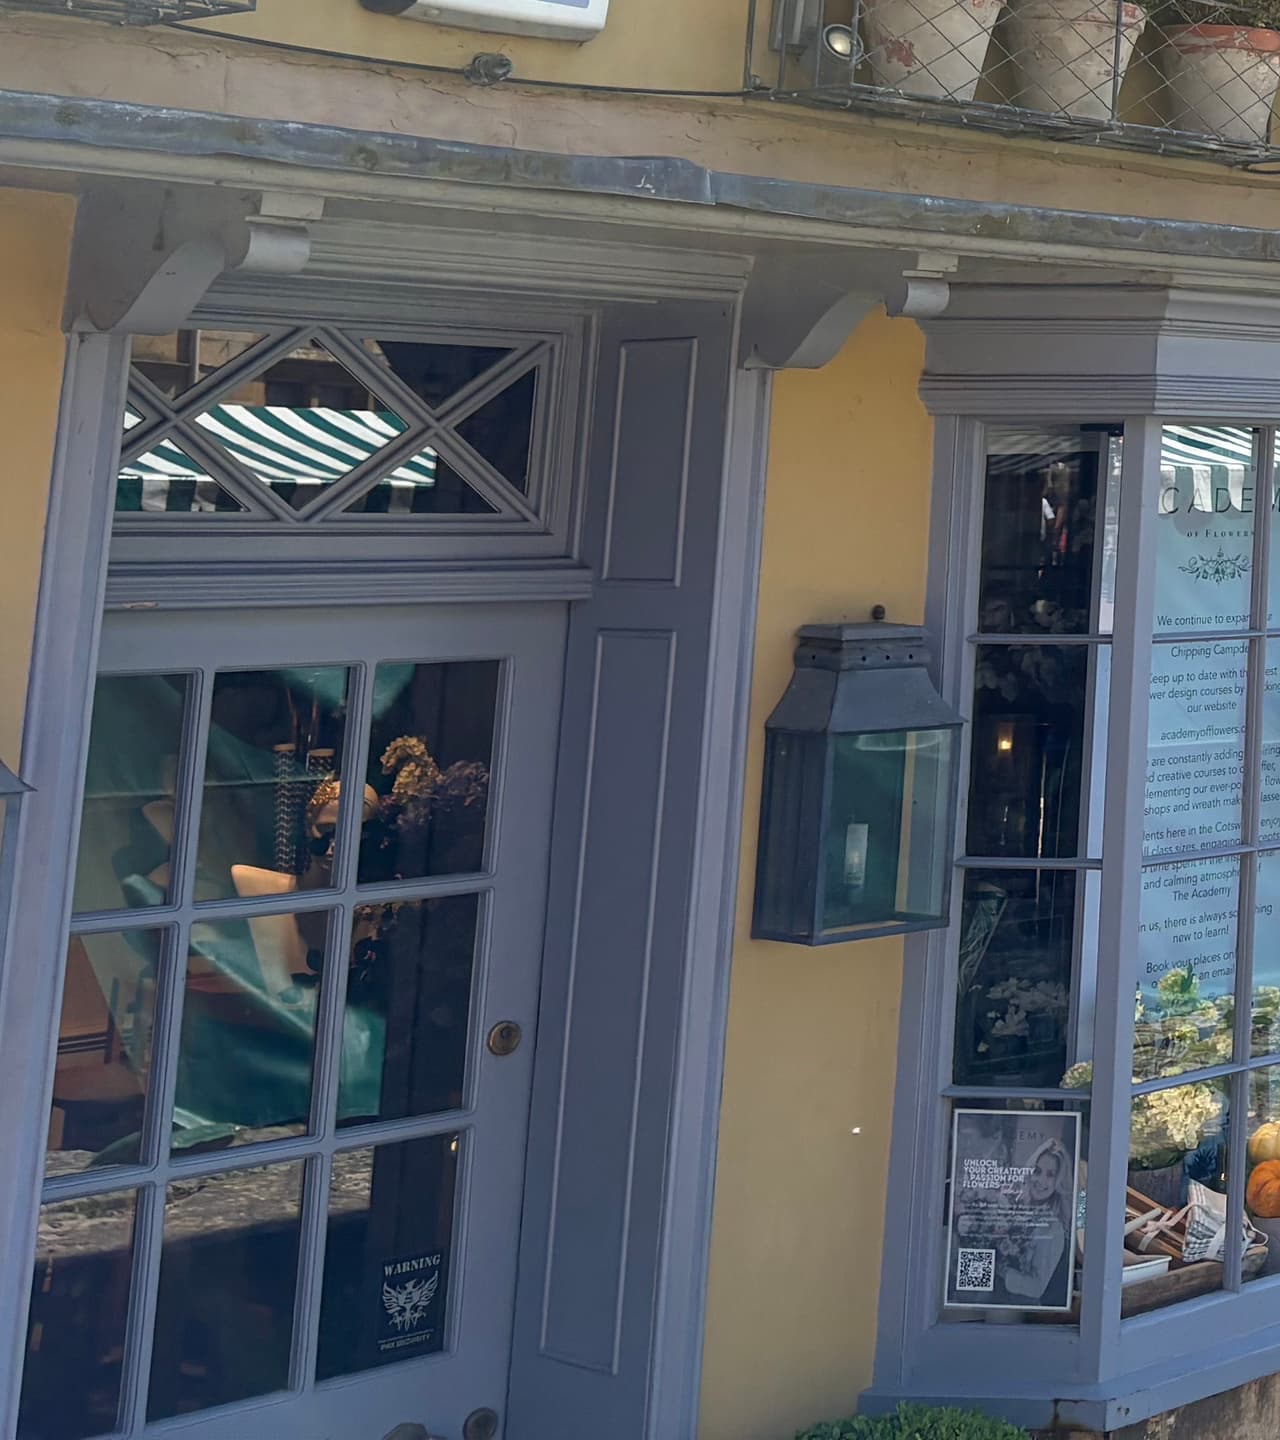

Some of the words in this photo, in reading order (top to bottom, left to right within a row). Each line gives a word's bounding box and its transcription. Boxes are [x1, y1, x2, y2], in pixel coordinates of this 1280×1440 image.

[1157, 615, 1172, 626] We
[1175, 614, 1212, 626] continue
[1215, 613, 1224, 624] to
[1171, 644, 1211, 659] Chipping
[1172, 672, 1184, 685] up
[1187, 671, 1196, 682] to
[1198, 669, 1218, 681] date
[1220, 667, 1238, 679] with
[1168, 686, 1197, 701] design
[1200, 685, 1232, 697] courses
[1235, 682, 1244, 696] by
[1187, 703, 1201, 713] our
[1204, 700, 1237, 712] website
[1152, 757, 1165, 767] are
[1168, 749, 1213, 765] constantly
[1214, 748, 1244, 763] adding
[1157, 770, 1191, 783] creative
[1194, 767, 1226, 778] courses
[1228, 765, 1237, 775] to
[1193, 784, 1207, 794] our
[1173, 800, 1189, 812] and
[1192, 798, 1221, 810] wreath
[1167, 827, 1186, 839] here
[1188, 826, 1197, 836] in
[1199, 824, 1213, 835] the
[1152, 844, 1173, 856] class
[1143, 876, 1160, 889] and
[1163, 872, 1197, 889] calming
[1173, 890, 1189, 902] The
[1192, 886, 1231, 902] Academy
[1149, 921, 1161, 932] us,
[1164, 915, 1186, 928] there
[1189, 913, 1196, 924] is
[1198, 909, 1227, 924] always
[1173, 933, 1191, 943] new
[1193, 930, 1203, 940] to
[1205, 926, 1229, 938] learn!
[1146, 961, 1170, 974] Book
[1194, 953, 1221, 967] places
[1198, 971, 1209, 981] an
[963, 1166, 986, 1174] YOUR
[987, 1167, 1035, 1175] CREATIVITY
[970, 1174, 1006, 1182] PASSION
[384, 1254, 440, 1277] WARNING
